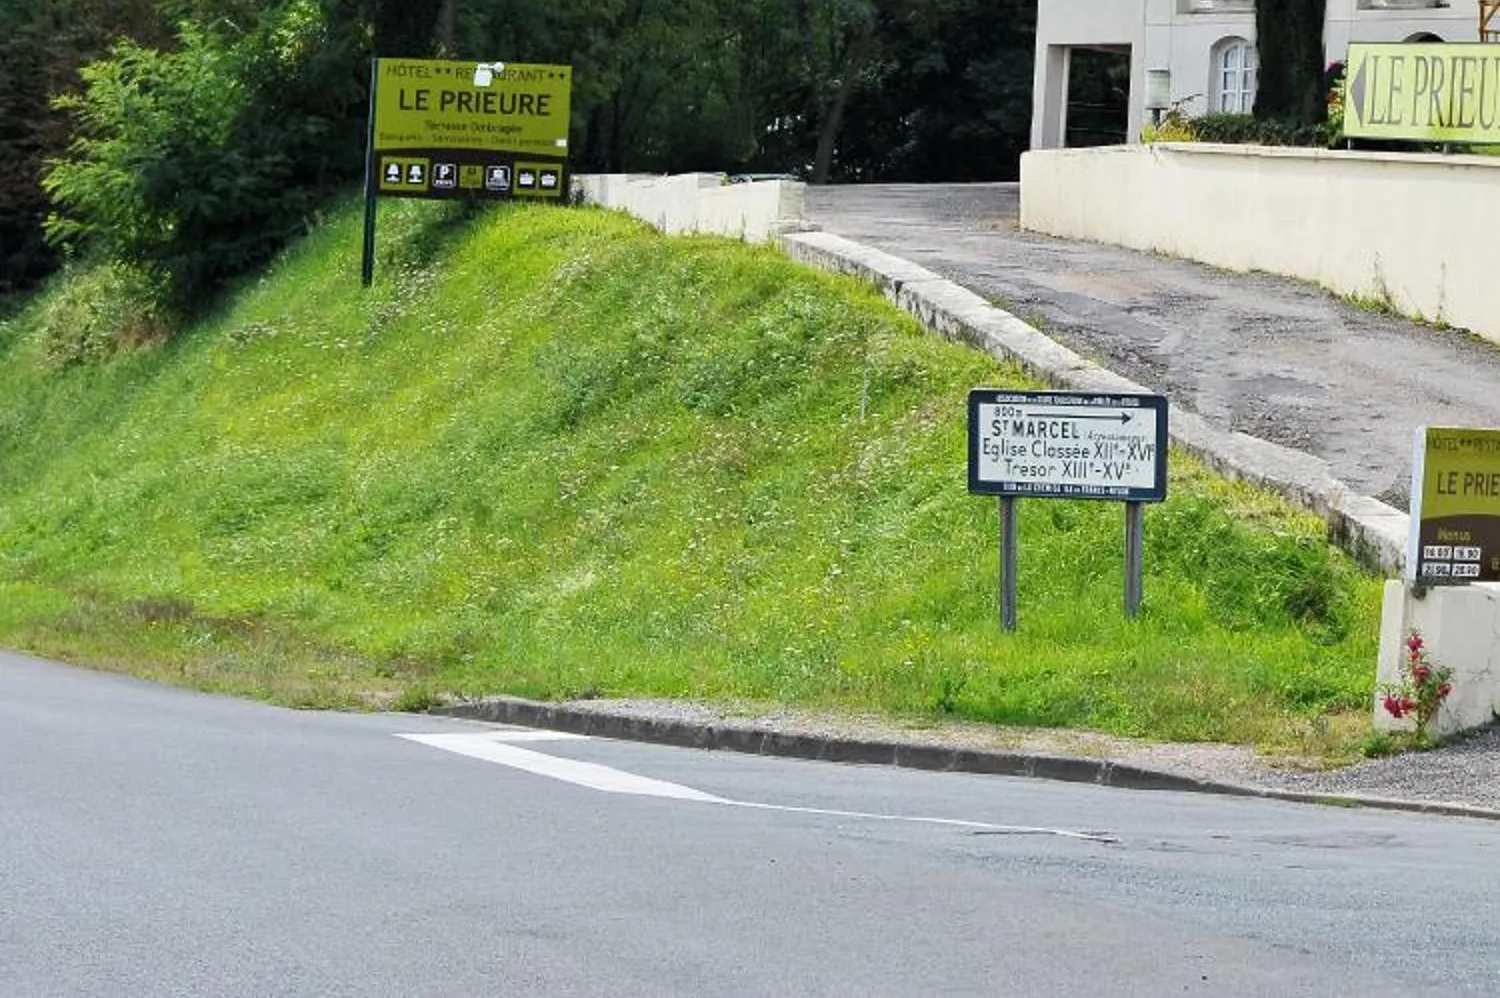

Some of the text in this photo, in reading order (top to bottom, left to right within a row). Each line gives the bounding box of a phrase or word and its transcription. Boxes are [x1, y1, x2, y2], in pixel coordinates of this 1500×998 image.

[386, 65, 545, 82] HÔTEL REURANT
[1367, 55, 1405, 125] LE
[400, 89, 552, 116] LE PRIEURE
[1012, 420, 1080, 439] MARCEL
[983, 438, 1027, 463] Eglise
[1031, 441, 1090, 459] Classée
[1004, 458, 1057, 478] Trésor
[1437, 471, 1459, 495] LE
